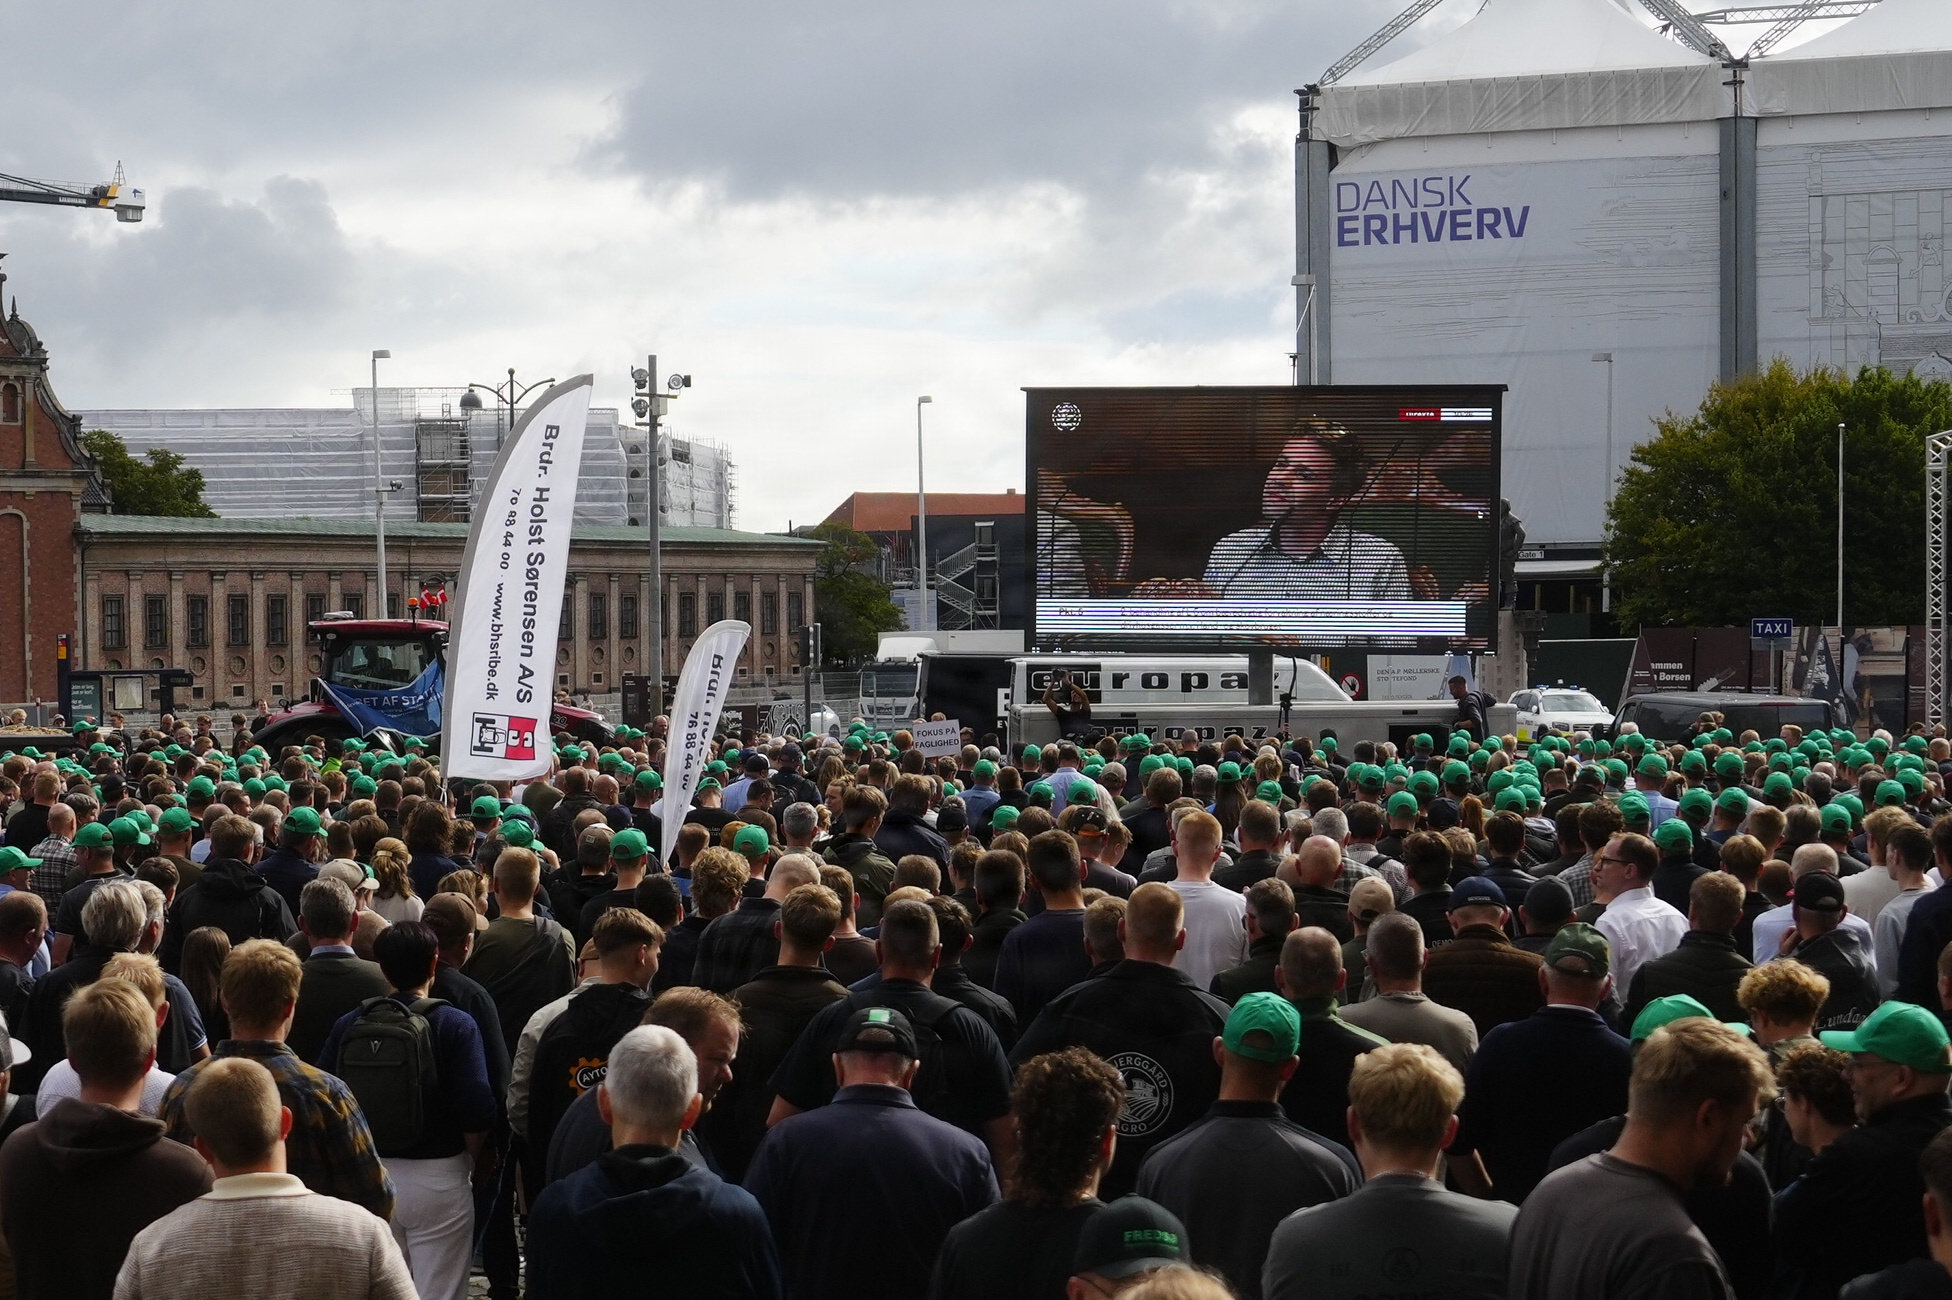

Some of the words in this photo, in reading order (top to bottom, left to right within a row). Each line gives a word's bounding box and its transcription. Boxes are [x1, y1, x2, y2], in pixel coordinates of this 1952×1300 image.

[1337, 175, 1472, 213] DANSK
[1337, 205, 1530, 247] ERHVERV
[538, 424, 560, 478] Brdr.
[504, 510, 517, 526] 88
[528, 487, 550, 545] Holst
[502, 531, 514, 548] 44
[499, 552, 510, 570] 00
[520, 551, 545, 657] Sørensen
[485, 582, 504, 700] www.bhsribe.dk
[1756, 622, 1787, 634] TAXI
[516, 664, 535, 703] A/S
[915, 738, 960, 749] FAGLIGHED
[916, 728, 943, 737] FOKUS
[945, 726, 957, 735] PÅ
